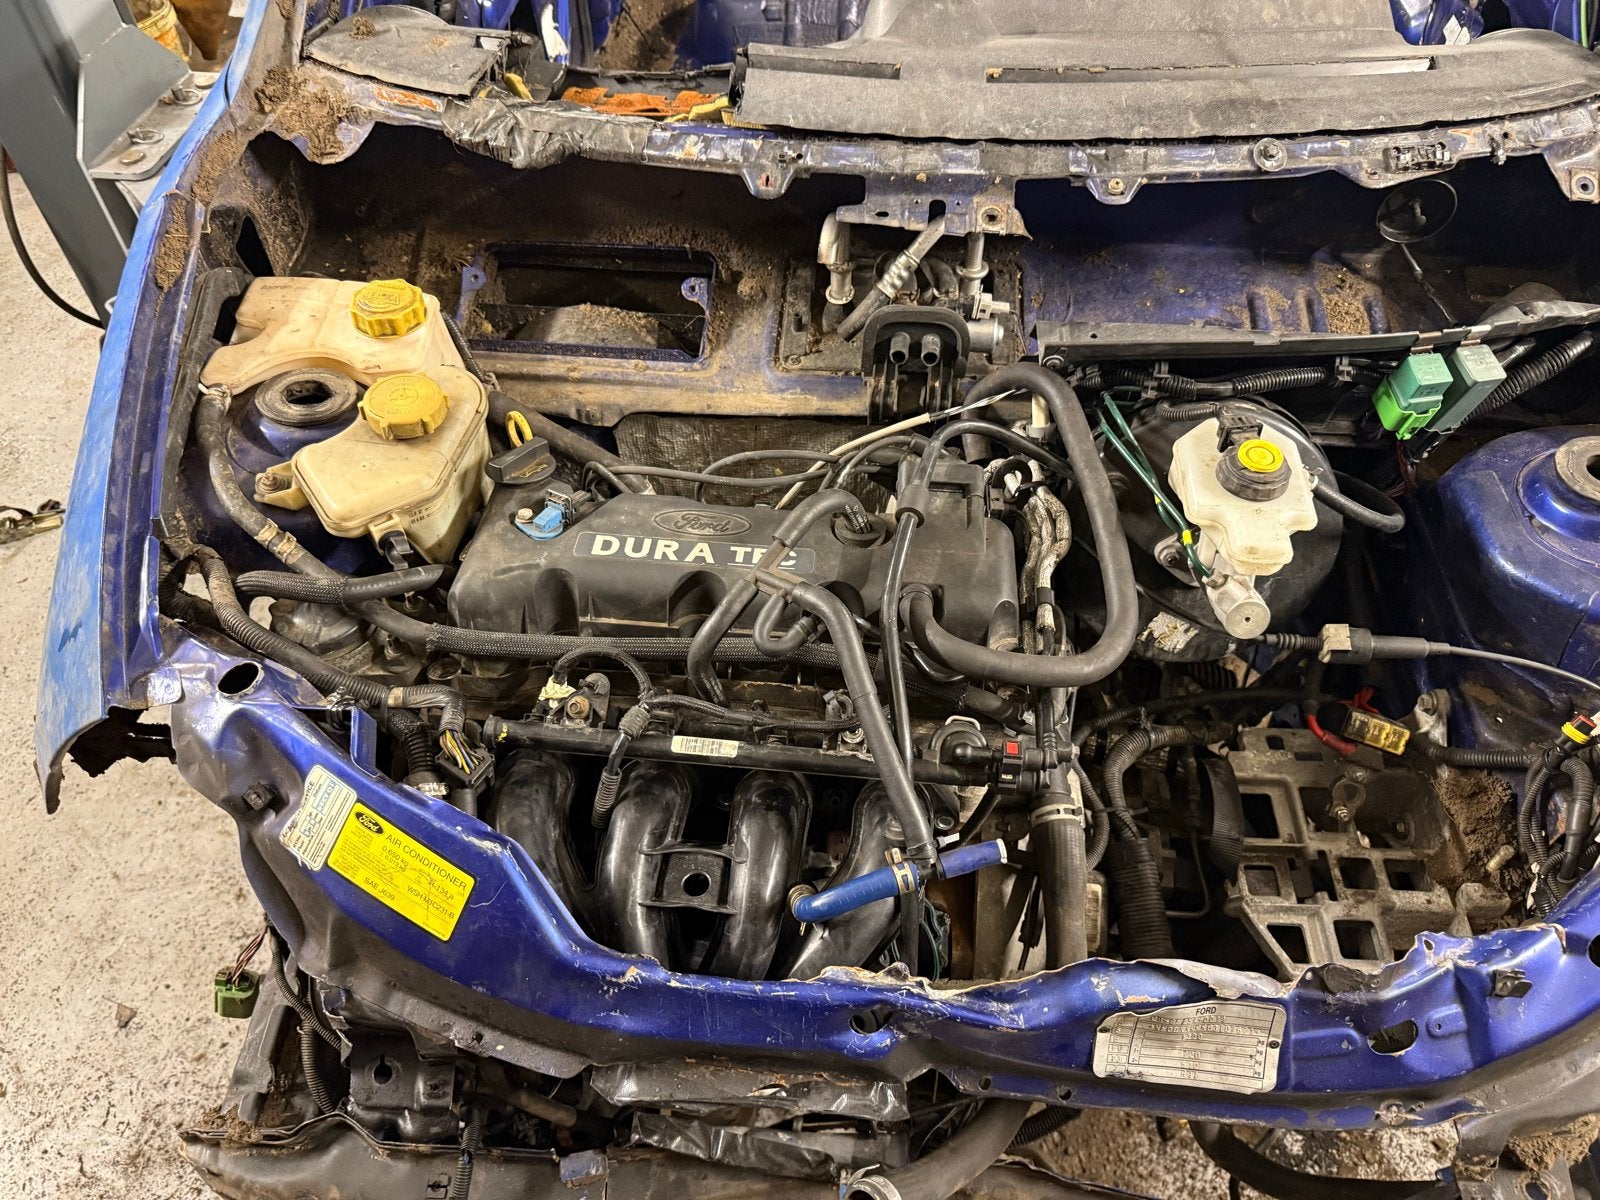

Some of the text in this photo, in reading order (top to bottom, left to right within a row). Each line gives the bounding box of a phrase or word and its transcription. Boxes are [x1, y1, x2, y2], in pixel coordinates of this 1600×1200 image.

[673, 512, 732, 532] Ford
[591, 534, 716, 565] DURA
[358, 814, 380, 832] Ford
[386, 834, 402, 849] AIR
[402, 845, 468, 891] CONDITIONER
[364, 877, 380, 890] SAE
[1195, 1006, 1217, 1016] FORD
